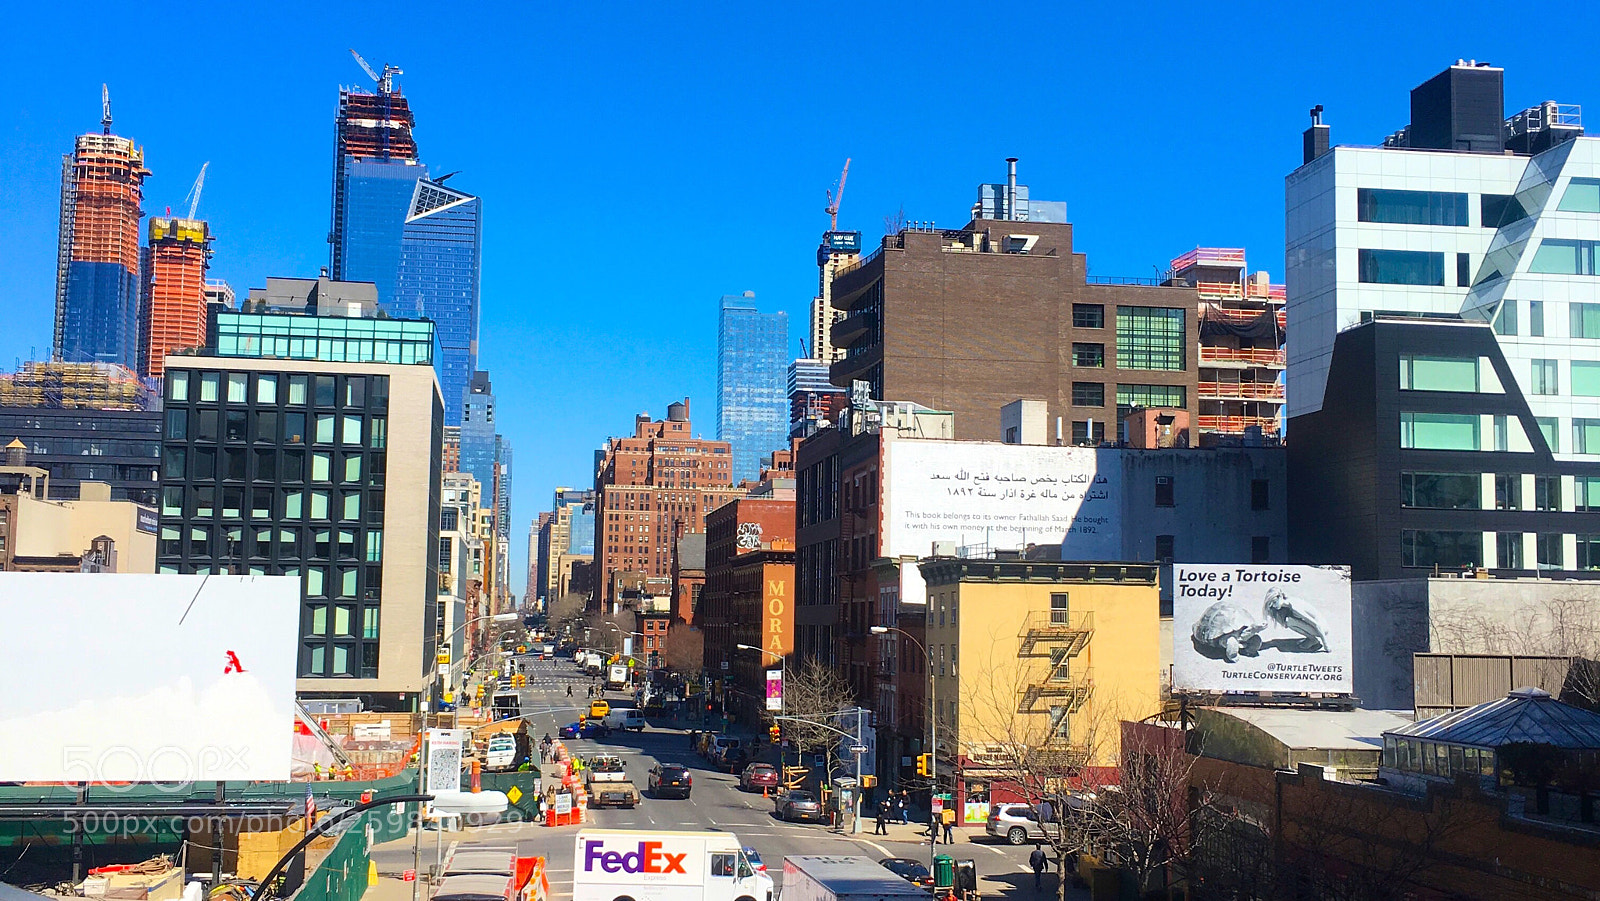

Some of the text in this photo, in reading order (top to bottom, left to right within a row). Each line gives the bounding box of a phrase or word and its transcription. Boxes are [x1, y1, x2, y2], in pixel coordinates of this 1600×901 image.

[954, 467, 970, 481] الله
[973, 472, 990, 485] فتح
[994, 473, 1027, 484] صاحبه
[1030, 474, 1058, 486] يخص
[1061, 473, 1090, 486] الكتاب
[1093, 474, 1108, 484] هذا
[947, 487, 1109, 502] اشتراه من ماله غرة اذار سنة ١٨٩٢
[904, 510, 920, 519] This
[922, 511, 941, 519] book
[943, 511, 970, 521] belongs
[1019, 513, 1050, 522] Fathallah
[1071, 514, 1082, 522] He
[1083, 515, 1108, 525] bought
[912, 522, 928, 530] with
[930, 522, 940, 530] his
[960, 525, 985, 533] money
[1009, 525, 1043, 534] beginning
[1178, 569, 1301, 583] Love a Tortoise
[1179, 584, 1233, 600] Today!
[585, 840, 687, 874] FedEx
